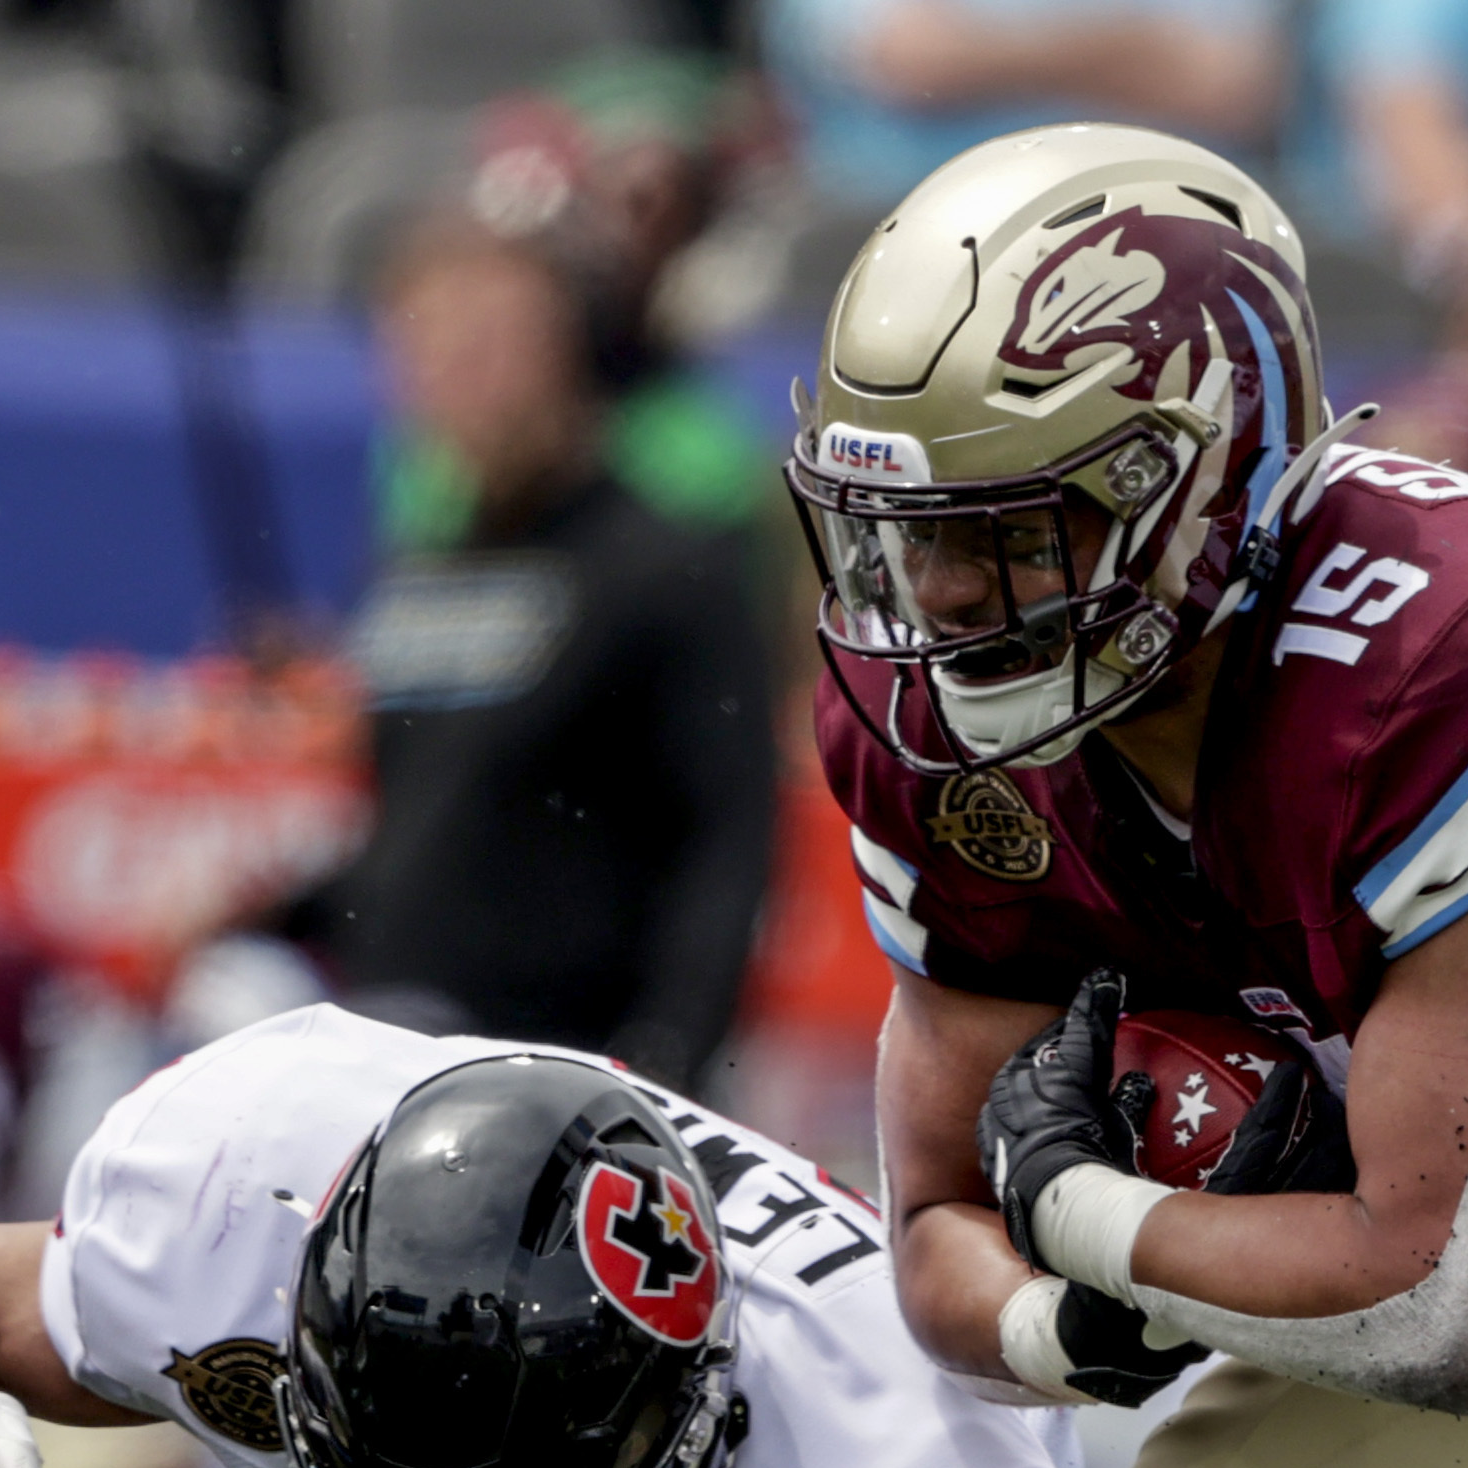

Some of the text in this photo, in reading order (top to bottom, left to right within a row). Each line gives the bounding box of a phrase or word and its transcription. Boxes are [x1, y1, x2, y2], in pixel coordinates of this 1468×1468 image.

[829, 434, 903, 472] USFL
[1272, 541, 1430, 668] 15
[962, 811, 1033, 837] USFL
[633, 1084, 884, 1288] LEW
